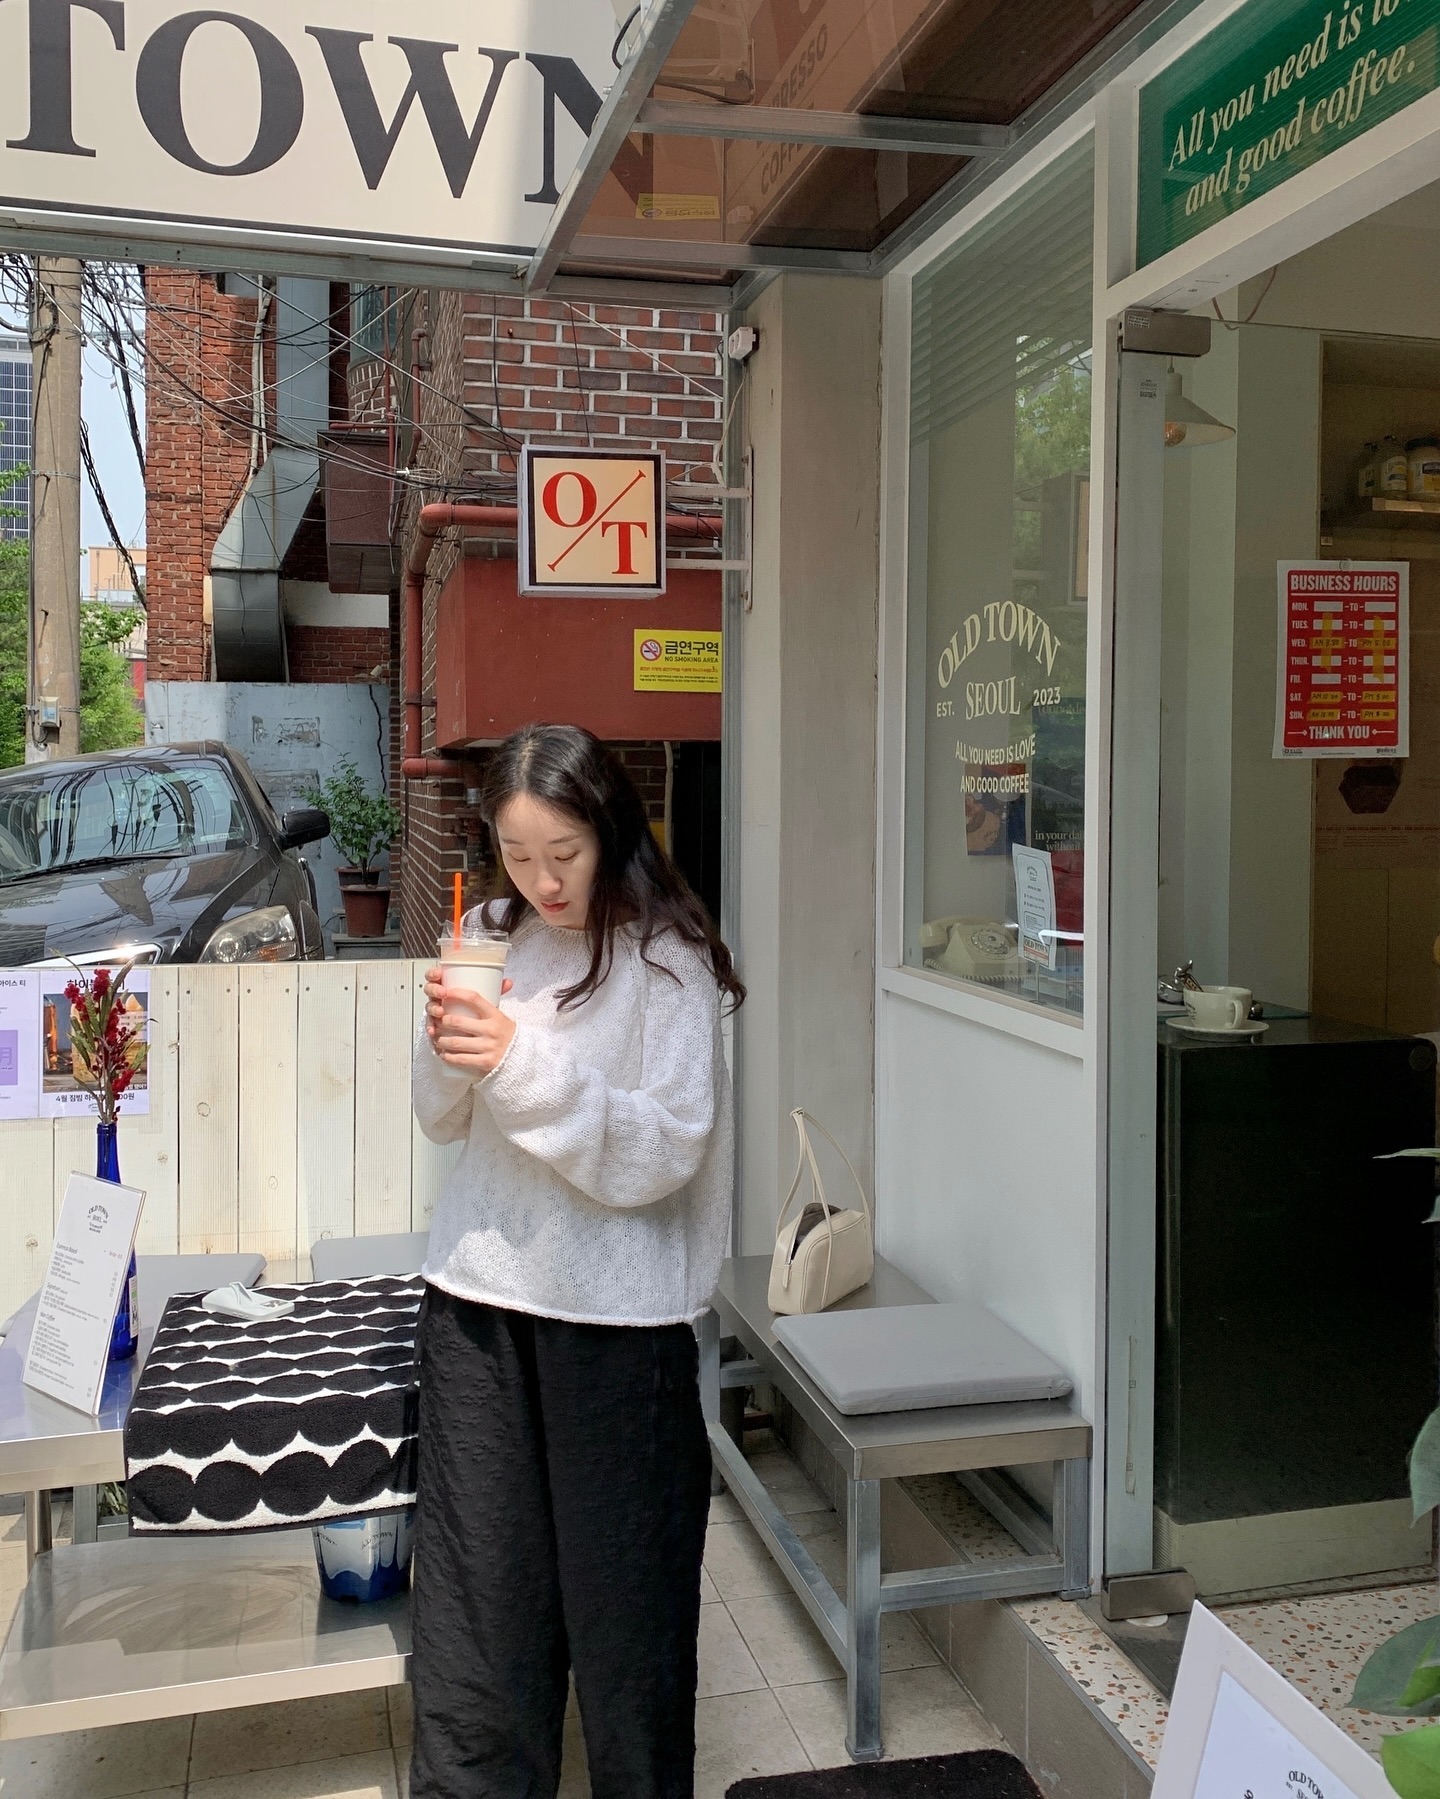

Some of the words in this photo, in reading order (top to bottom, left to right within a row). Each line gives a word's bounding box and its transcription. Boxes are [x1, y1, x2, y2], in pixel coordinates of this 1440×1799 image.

[1168, 106, 1206, 172] All
[1207, 84, 1255, 155] you
[1262, 10, 1333, 104] need
[1337, 0, 1363, 50] is
[6, 0, 654, 205] TOWN
[1185, 147, 1233, 216] and
[1235, 96, 1306, 194] good
[1310, 45, 1415, 130] coffee.
[1290, 574, 1351, 592] BUSINESS
[1353, 575, 1397, 592] HOURS
[1291, 602, 1308, 611] MON.
[1291, 620, 1309, 629] TUES.
[665, 640, 719, 656] 금연구역
[937, 613, 981, 689] OLD
[983, 600, 1061, 677] TOWN
[1291, 638, 1307, 648] WED.
[1291, 656, 1309, 666] THUR.
[1290, 674, 1302, 684] FRI.
[936, 701, 955, 718] EST.
[965, 676, 1021, 720] SEOUL
[1032, 686, 1061, 707] 2023
[1290, 692, 1302, 702] SAT.
[1289, 710, 1304, 720] SUN.
[1308, 725, 1345, 740] THANK
[1347, 725, 1370, 739] YOU
[955, 740, 968, 762] ALL
[969, 746, 984, 765] YOU
[984, 748, 1005, 766] NEED
[1006, 745, 1014, 763] IS
[1015, 733, 1036, 761] LOVE
[960, 775, 975, 794] AND
[976, 775, 998, 794] GOOD
[999, 773, 1030, 794] COFFEE
[1035, 829, 1045, 840] in
[1045, 832, 1068, 844] your
[55, 1094, 67, 1102] 4월
[1288, 1770, 1307, 1784] OLD
